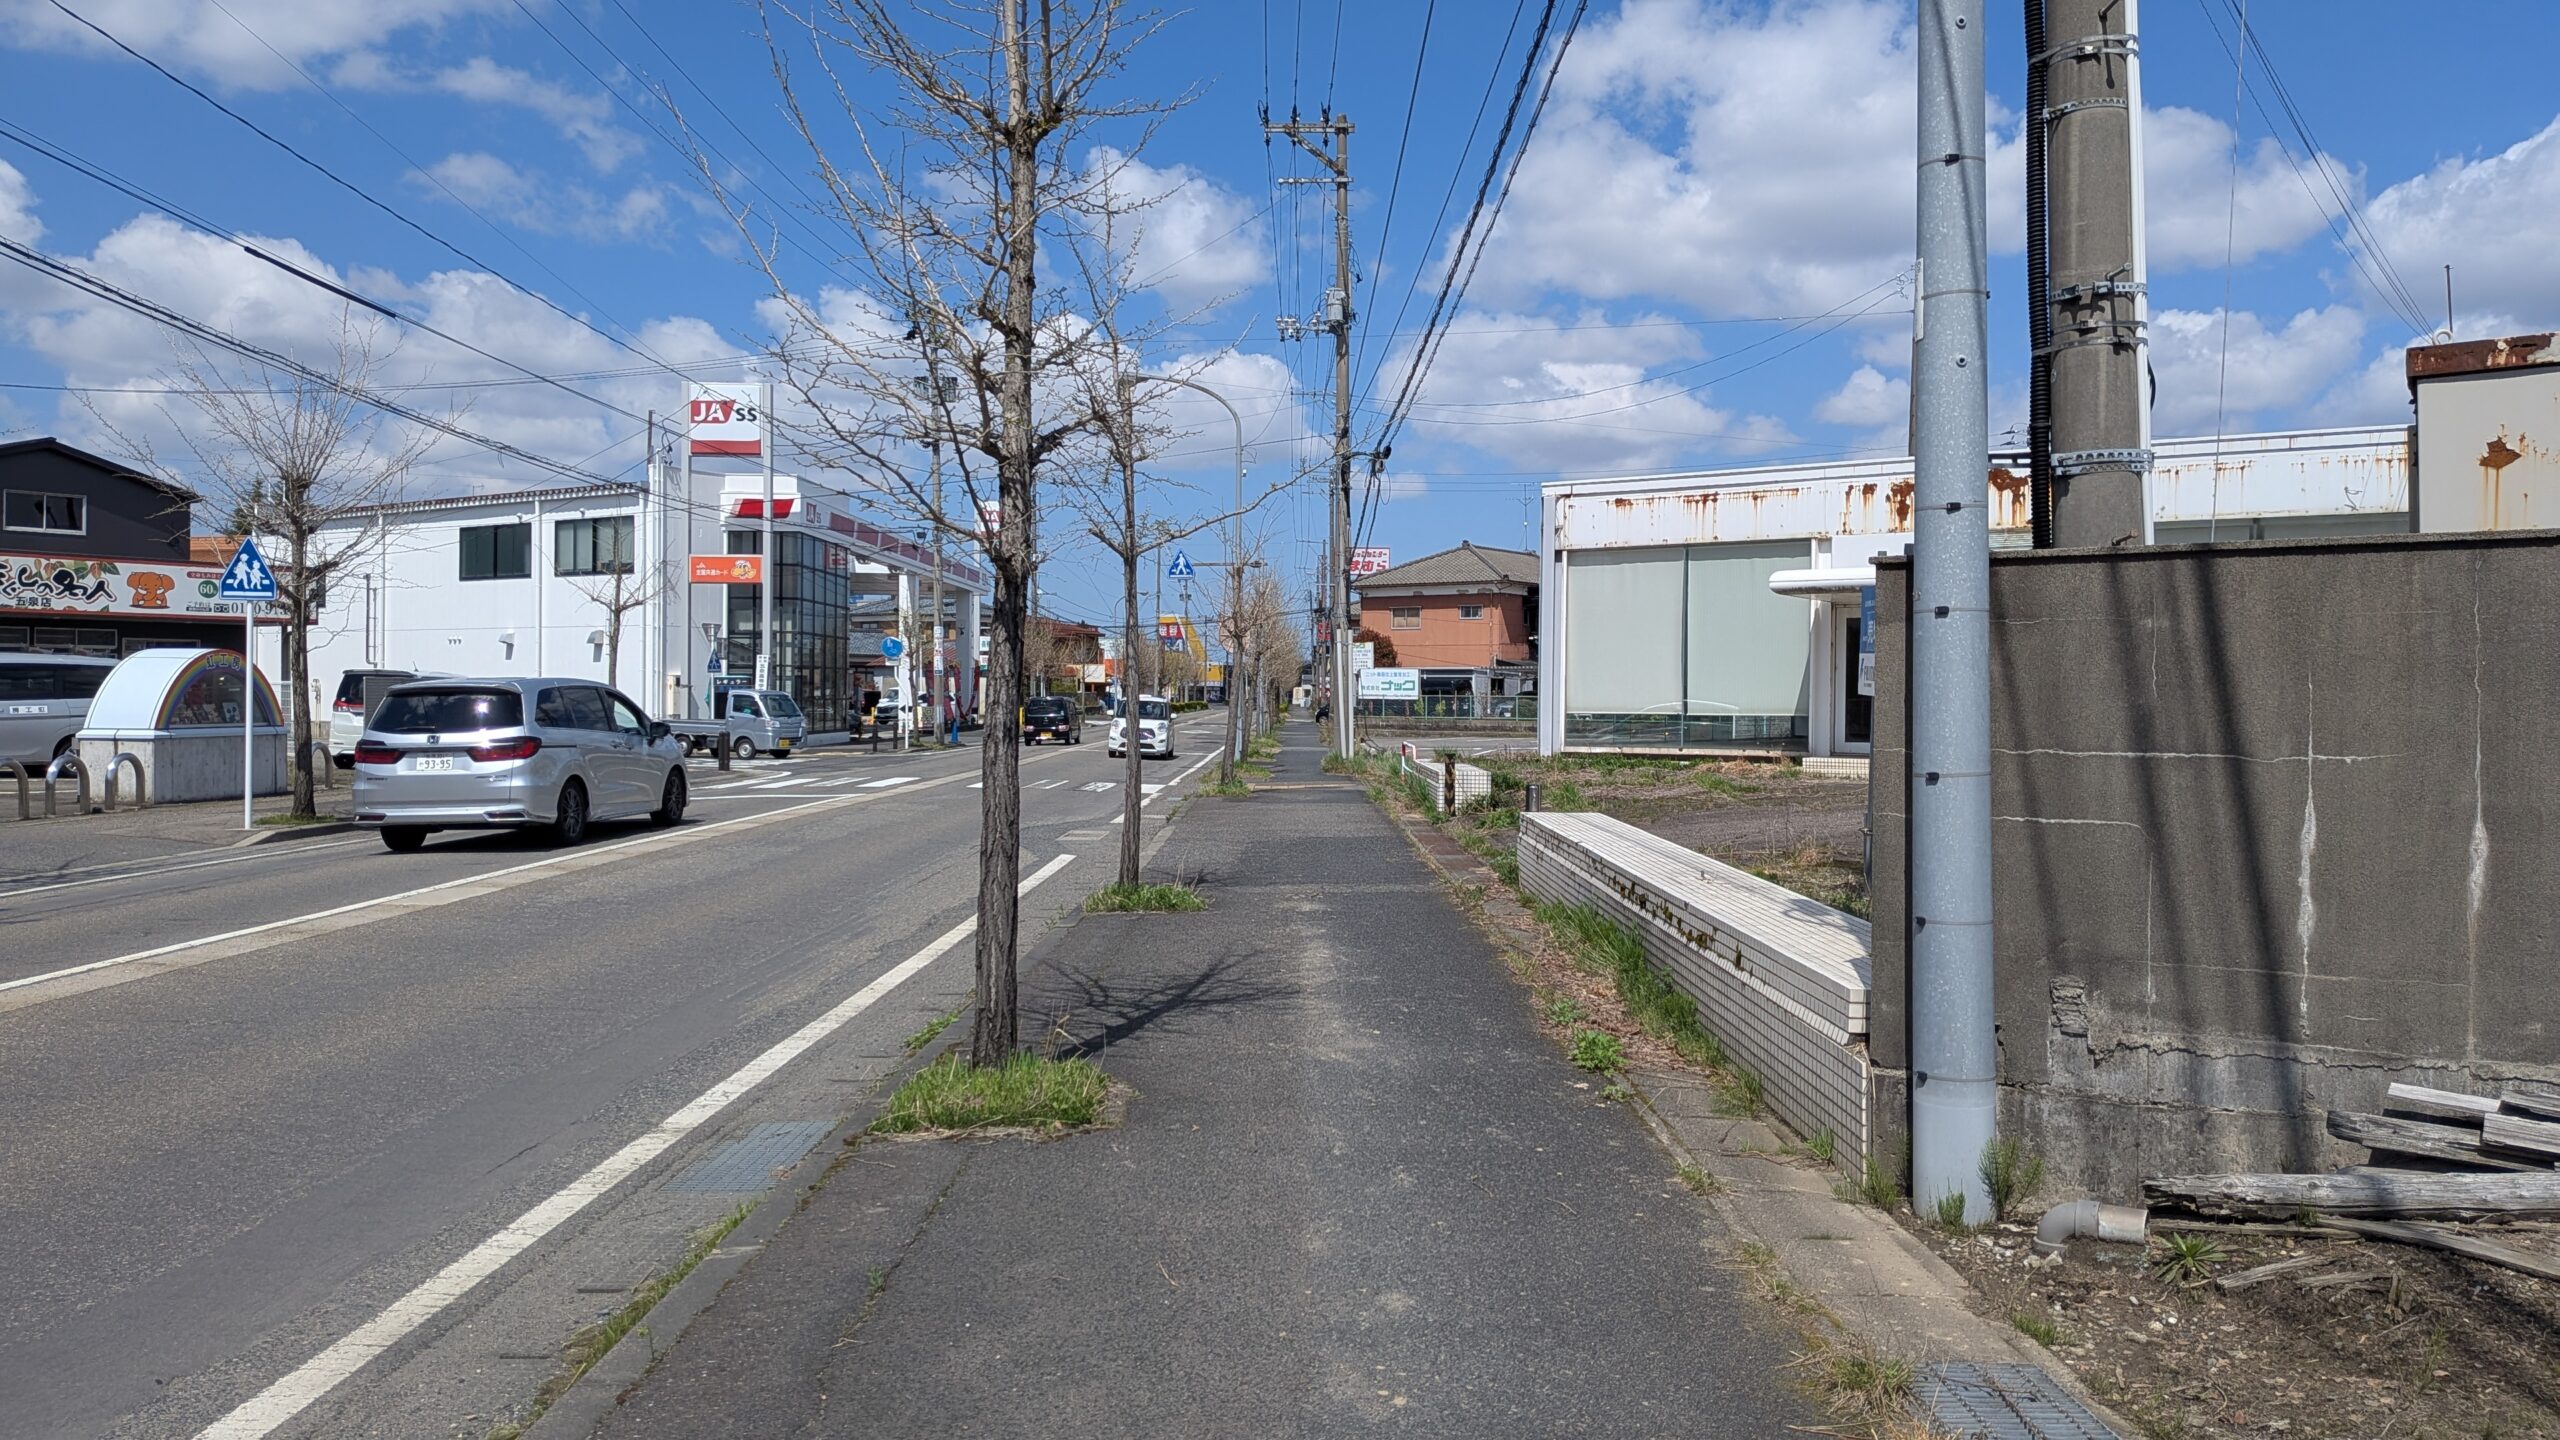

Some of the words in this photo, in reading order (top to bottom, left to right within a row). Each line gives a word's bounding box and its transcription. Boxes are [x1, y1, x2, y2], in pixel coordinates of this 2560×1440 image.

[694, 403, 726, 421] JA
[736, 408, 757, 421] SS
[16, 596, 51, 607] 五泉店
[206, 654, 240, 670] 虹工房
[1381, 680, 1416, 691] ナック
[424, 759, 451, 769] 93-95
